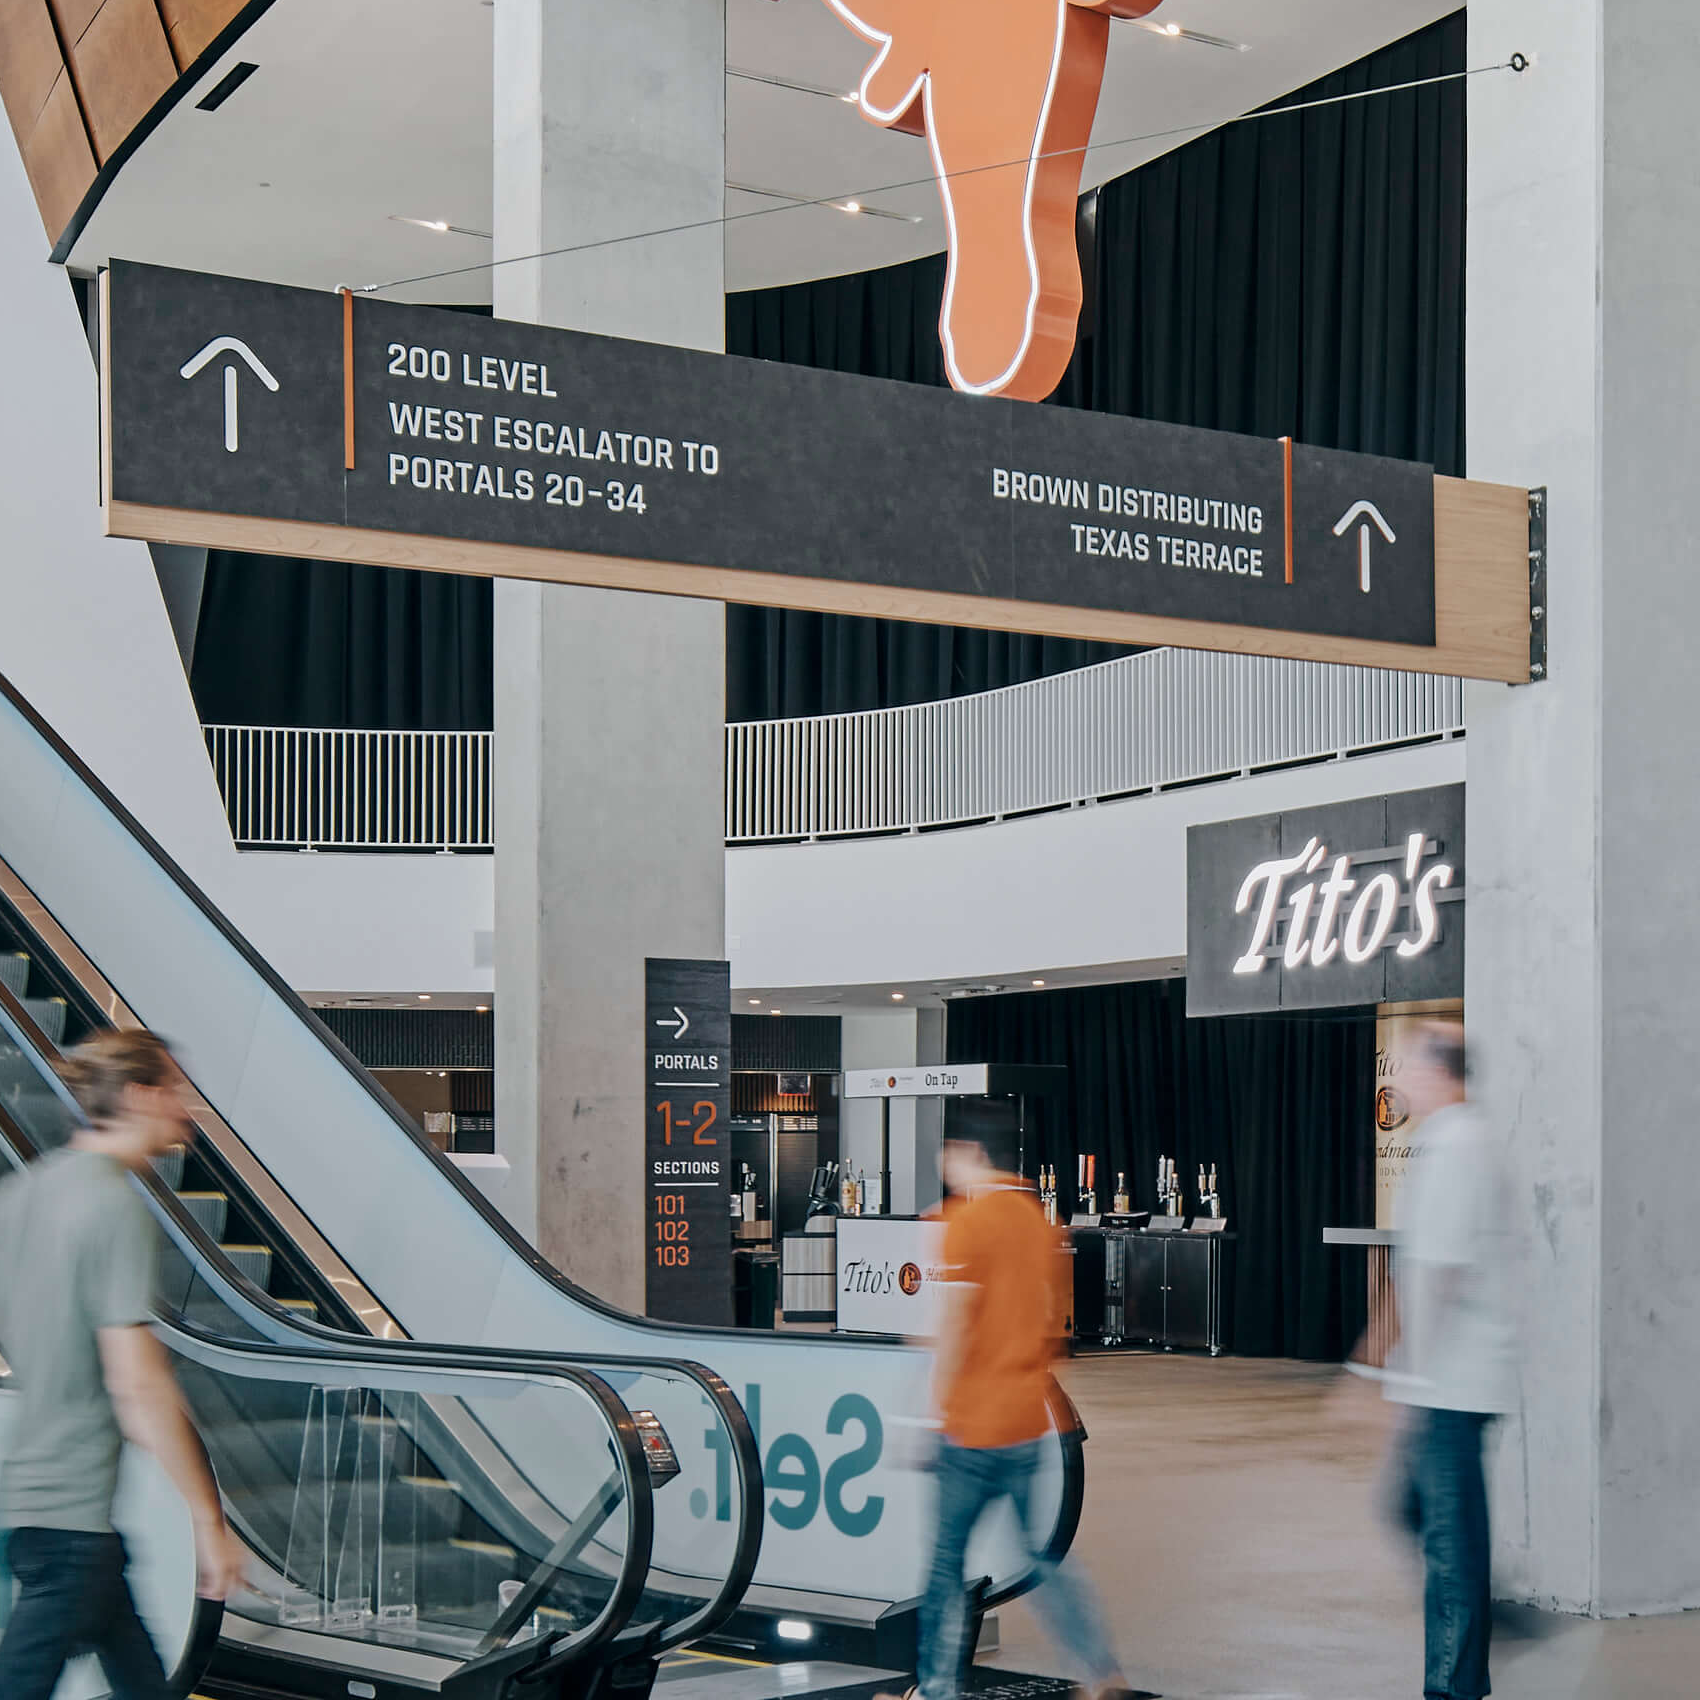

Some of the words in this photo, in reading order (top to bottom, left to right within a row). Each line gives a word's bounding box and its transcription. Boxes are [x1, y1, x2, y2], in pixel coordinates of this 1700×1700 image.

[387, 342, 451, 382] 200
[462, 354, 557, 398] LEVEL
[388, 402, 484, 445] WEST
[493, 416, 674, 470] ESCALATOR
[682, 441, 719, 476] TO
[388, 453, 535, 501] PORTALS
[545, 473, 647, 515] 20-34
[992, 467, 1089, 509] BROWN
[1098, 483, 1263, 534] DISTRIBUTING
[1070, 523, 1150, 561] TEXAS
[1156, 535, 1264, 577] TERRACE
[1232, 832, 1455, 974] Tito's
[654, 1054, 719, 1070] PORTALS
[925, 1073, 938, 1086] On
[940, 1073, 958, 1089] Tap
[656, 1100, 717, 1145] 1-2
[654, 1161, 720, 1175] SECTIONS
[655, 1195, 685, 1215] 101
[655, 1221, 690, 1241] 102
[655, 1246, 690, 1267] 103
[843, 1257, 896, 1295] Tito's
